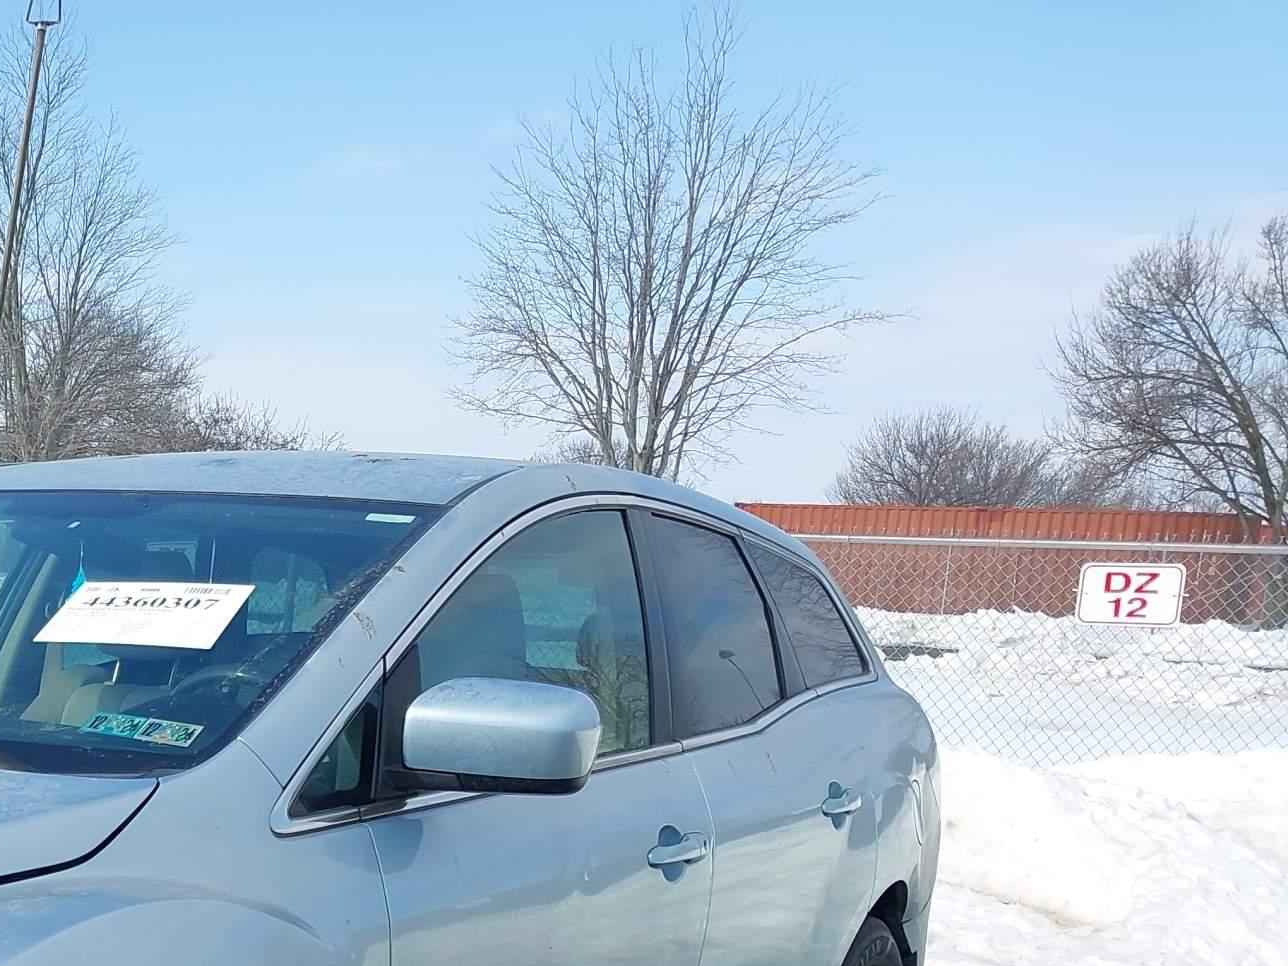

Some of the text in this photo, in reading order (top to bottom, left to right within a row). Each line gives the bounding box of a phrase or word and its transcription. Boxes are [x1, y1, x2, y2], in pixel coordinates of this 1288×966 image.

[1103, 572, 1161, 594] DZ
[81, 596, 220, 610] 44360307
[1107, 597, 1148, 618] 12
[88, 715, 108, 729] 12
[140, 722, 162, 737] 12
